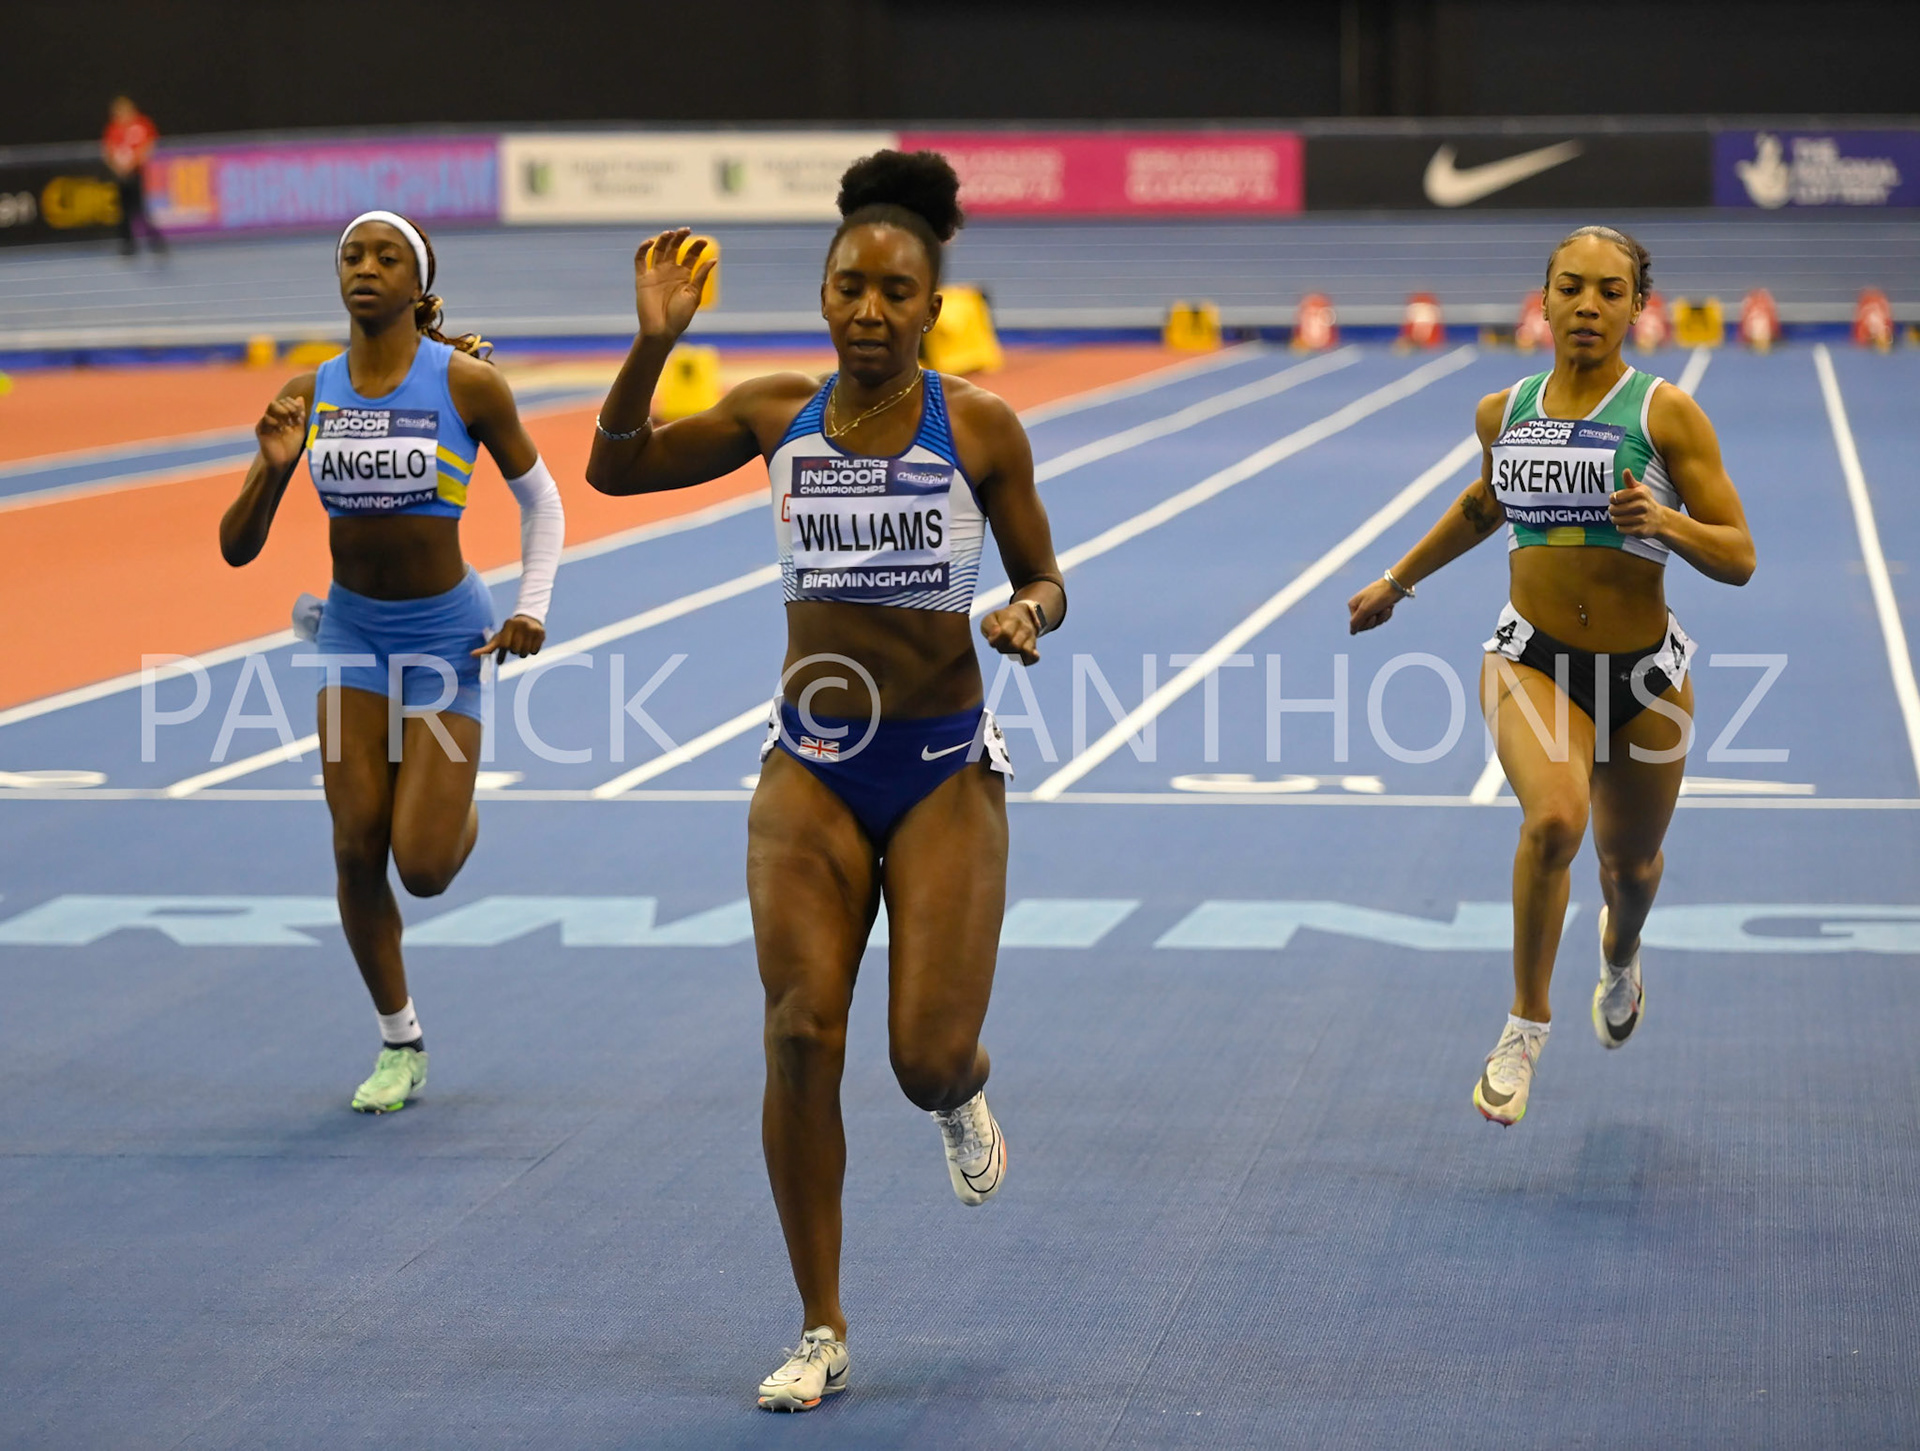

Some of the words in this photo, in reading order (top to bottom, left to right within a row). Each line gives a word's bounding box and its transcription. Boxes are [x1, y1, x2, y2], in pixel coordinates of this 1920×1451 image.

[324, 418, 389, 432] INDOOR
[1505, 429, 1571, 439] INDOOR
[321, 449, 426, 481] ANGELO
[801, 469, 886, 485] INDOOR
[1498, 459, 1605, 494] SKERVIN
[800, 485, 885, 494] CHAMPIONSHIPS
[797, 509, 942, 551] WILLIAMS
[802, 568, 942, 588] BIRMINGHAM
[1494, 616, 1517, 643] 4
